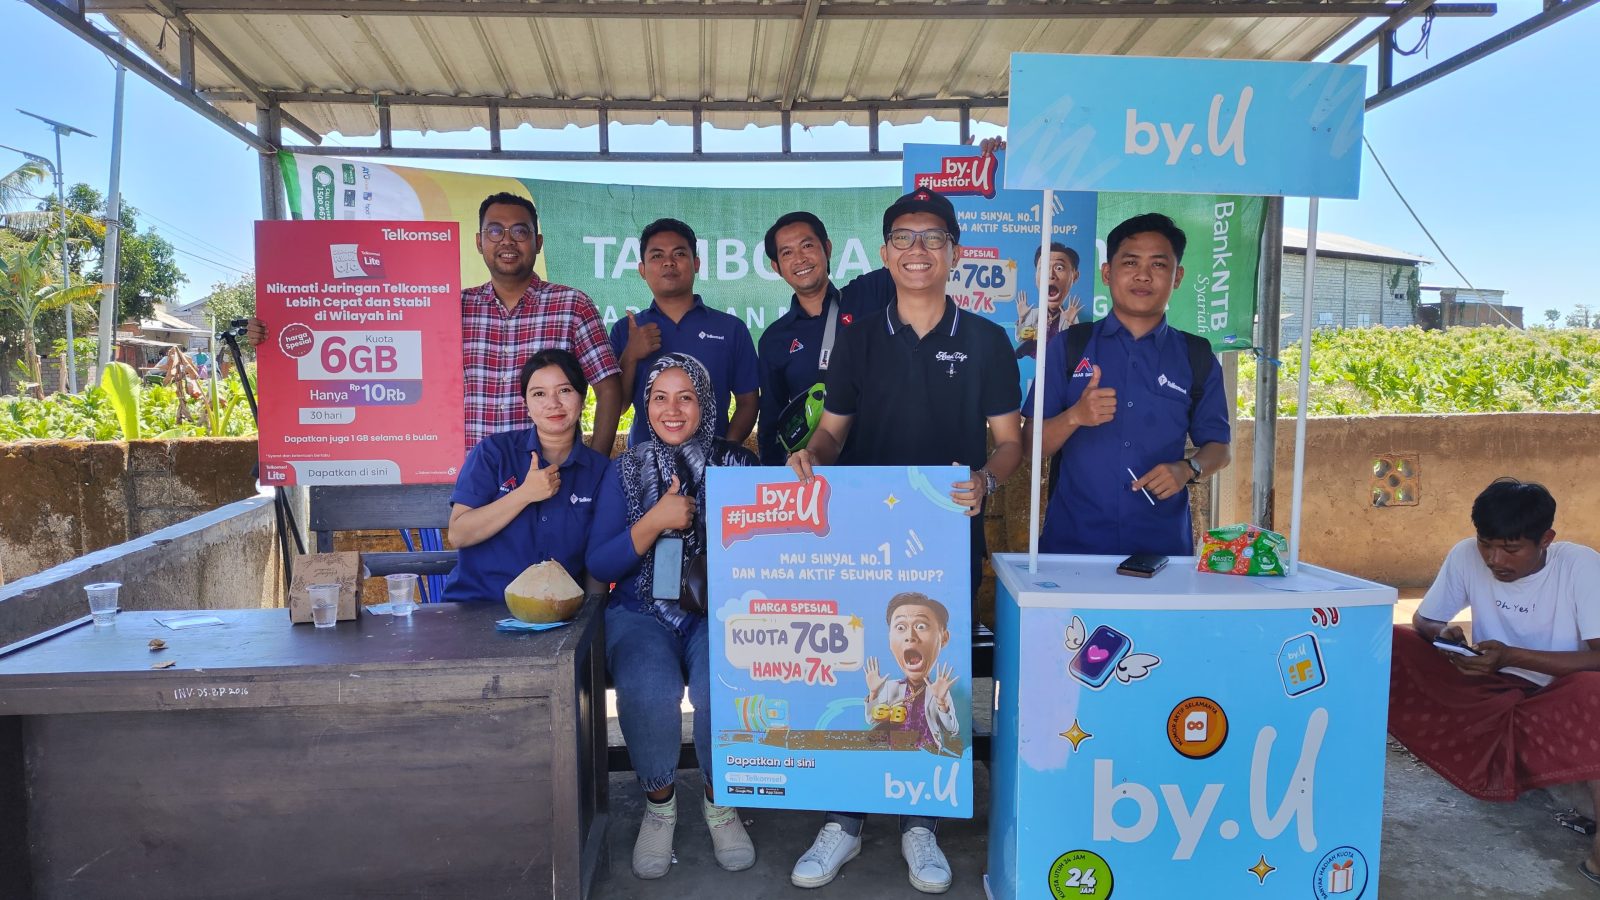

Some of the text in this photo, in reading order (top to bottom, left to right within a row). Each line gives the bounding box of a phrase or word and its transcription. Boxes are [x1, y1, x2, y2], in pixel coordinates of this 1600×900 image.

[1124, 86, 1254, 166] by.U
[946, 156, 991, 190] by.U
[918, 176, 970, 189] #justfor
[957, 211, 977, 220] MAU
[980, 211, 1014, 222] SINYAL
[381, 228, 452, 241] Telkomsel
[970, 223, 999, 233] AKTIF
[1002, 224, 1040, 234] SEUMUR
[963, 249, 996, 258] SPESIAL
[363, 256, 381, 266] Lite
[963, 264, 1006, 289] 7GB
[266, 282, 450, 297] Nikmati Jaringan Telkomsel
[286, 296, 431, 310] Lebih Cepat dan Stabil
[972, 291, 994, 311] 7K
[1193, 273, 1210, 333] Syariah
[314, 310, 403, 324] di Wilayah ini
[285, 332, 308, 342] harga
[365, 334, 393, 343] Kuota
[320, 335, 398, 374] 6GB
[310, 383, 406, 402] Hanya Rp 10Rb
[310, 411, 342, 420] 30 hari
[284, 435, 328, 445] Dapatkan
[329, 435, 349, 444] juga
[351, 434, 355, 442] 1
[356, 434, 369, 442] GB
[370, 434, 403, 442] selama
[412, 433, 438, 441] bulan
[267, 471, 286, 480] Lite
[308, 467, 388, 478] Dapatkan di sini
[762, 480, 821, 525] by.U
[727, 508, 796, 529] #justfor
[780, 553, 806, 565] MAU
[811, 553, 856, 567] SINYAL
[731, 567, 944, 583] DAN MASA AKTIF SEUMUR HIDUP?
[753, 602, 834, 614] HARGA SPESIAL
[1495, 600, 1511, 610] Oh
[732, 621, 849, 654] KUOTA 7GB
[752, 657, 834, 683] HANYA 7K
[726, 755, 816, 769] Dapatkan di sini
[884, 761, 960, 807] by.U
[1092, 707, 1329, 860] by.U
[1065, 867, 1097, 888] 24
